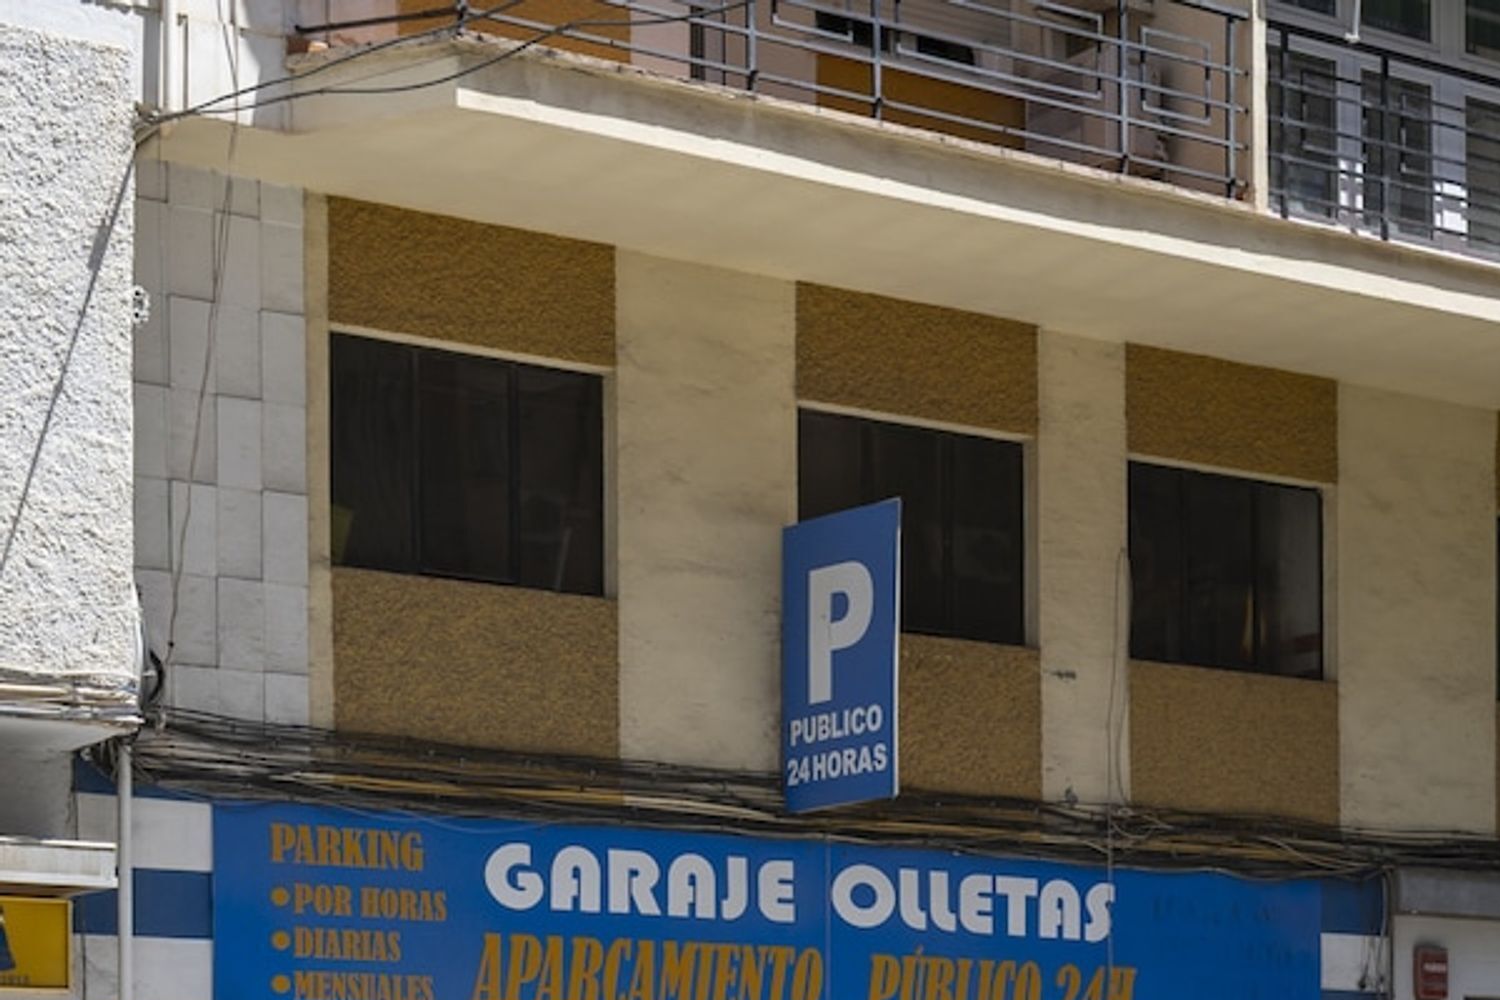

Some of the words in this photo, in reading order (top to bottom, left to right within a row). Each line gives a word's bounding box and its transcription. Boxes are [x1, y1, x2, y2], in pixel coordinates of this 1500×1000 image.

[807, 561, 875, 706] P
[789, 704, 882, 748] PUBLICO
[786, 756, 811, 788] 24
[812, 743, 888, 781] HORAS
[269, 822, 424, 872] PARKING
[293, 882, 352, 916] POR
[360, 887, 447, 922] HORAS
[484, 842, 796, 924] GARAJE
[830, 864, 1115, 944] OLLETAS
[294, 925, 401, 962] DIARIAS
